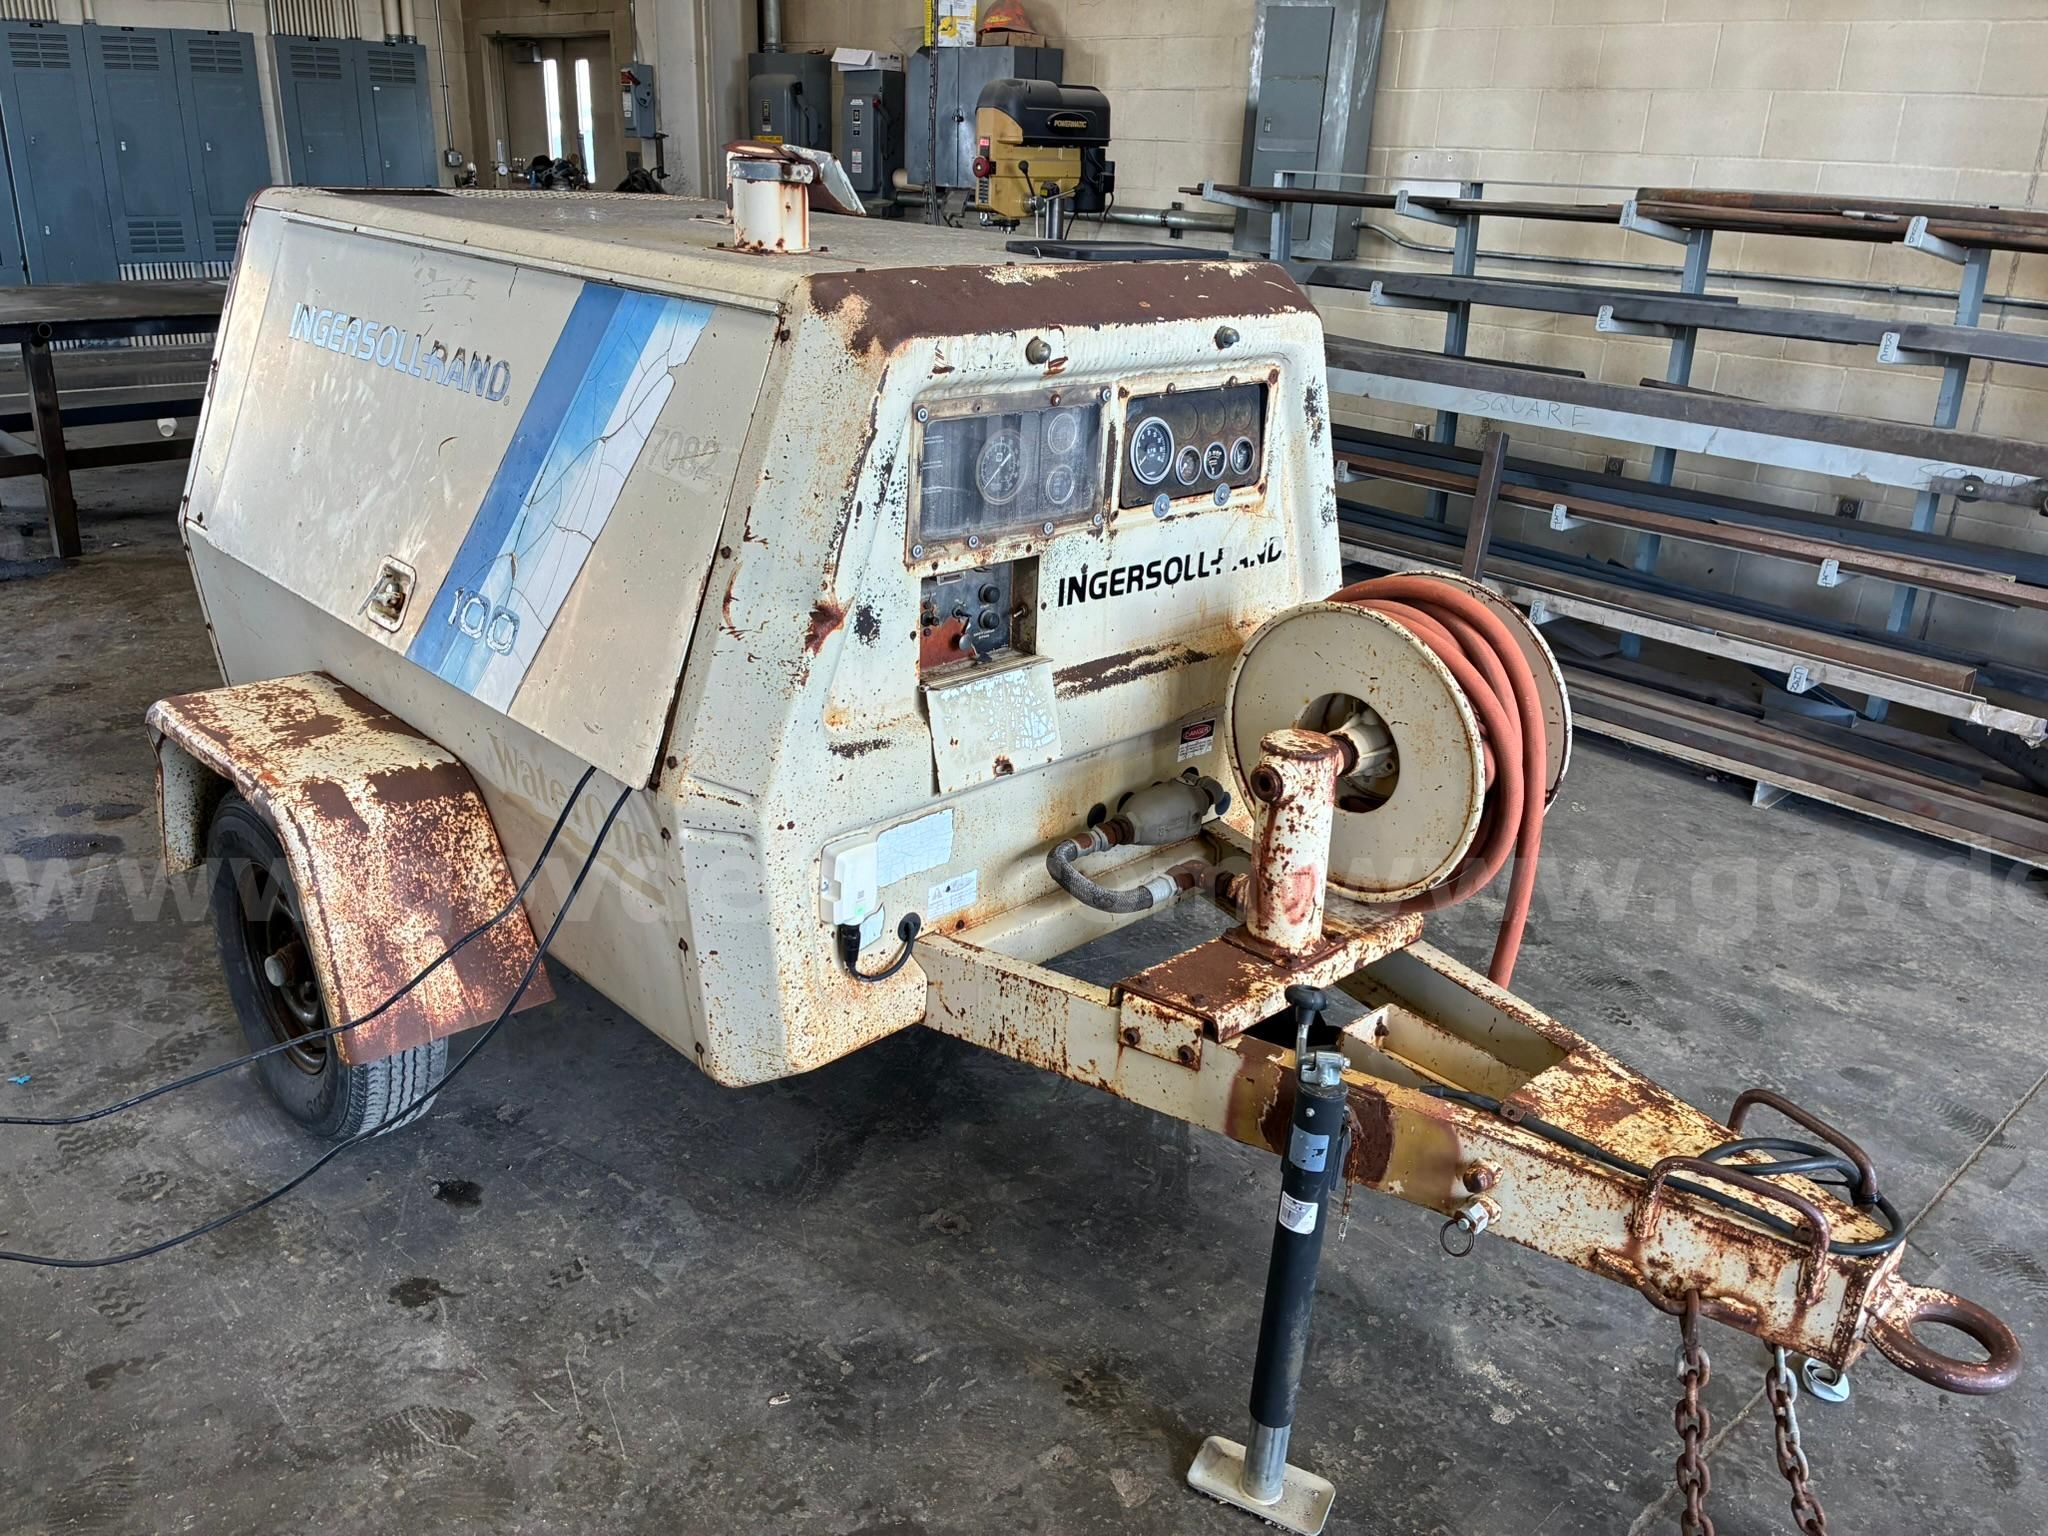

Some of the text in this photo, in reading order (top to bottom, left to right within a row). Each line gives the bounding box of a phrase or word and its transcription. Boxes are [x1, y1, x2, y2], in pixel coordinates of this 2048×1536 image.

[1053, 119, 1088, 128] POWERMATIC
[1879, 333, 1893, 362] REC
[1473, 391, 1591, 428] SQUARE
[447, 586, 521, 657] 100
[1184, 725, 1211, 738] DANGER
